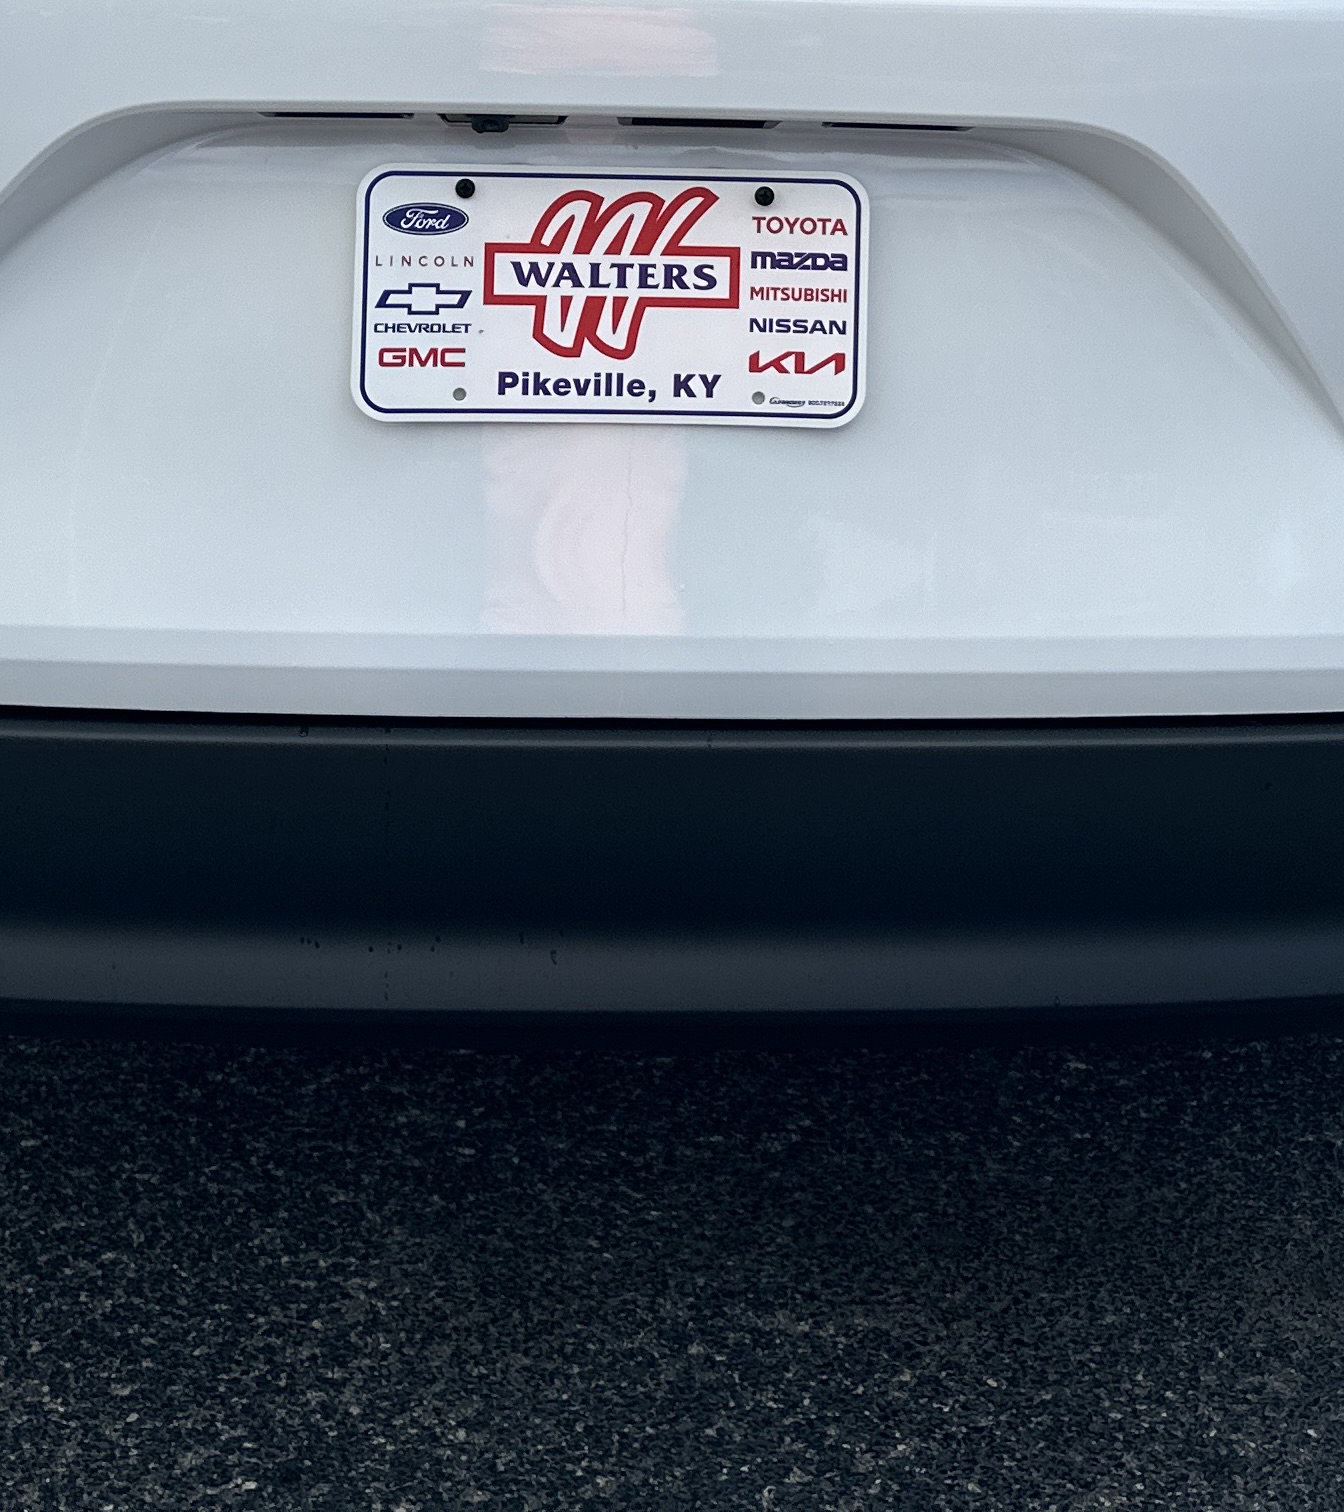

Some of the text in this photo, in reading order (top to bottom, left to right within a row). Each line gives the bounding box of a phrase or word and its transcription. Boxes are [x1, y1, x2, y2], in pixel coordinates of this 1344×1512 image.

[399, 204, 451, 231] Ford
[752, 215, 848, 237] TOYOTA
[375, 254, 474, 268] LINCOLN
[510, 260, 718, 291] WALTERS
[749, 285, 848, 304] MITSUBISHI
[373, 322, 472, 335] CHEVROLET
[749, 317, 847, 336] NISSAN
[377, 347, 467, 368] GMC
[748, 350, 846, 376] KIA
[497, 370, 722, 403] Pikeville, KY
